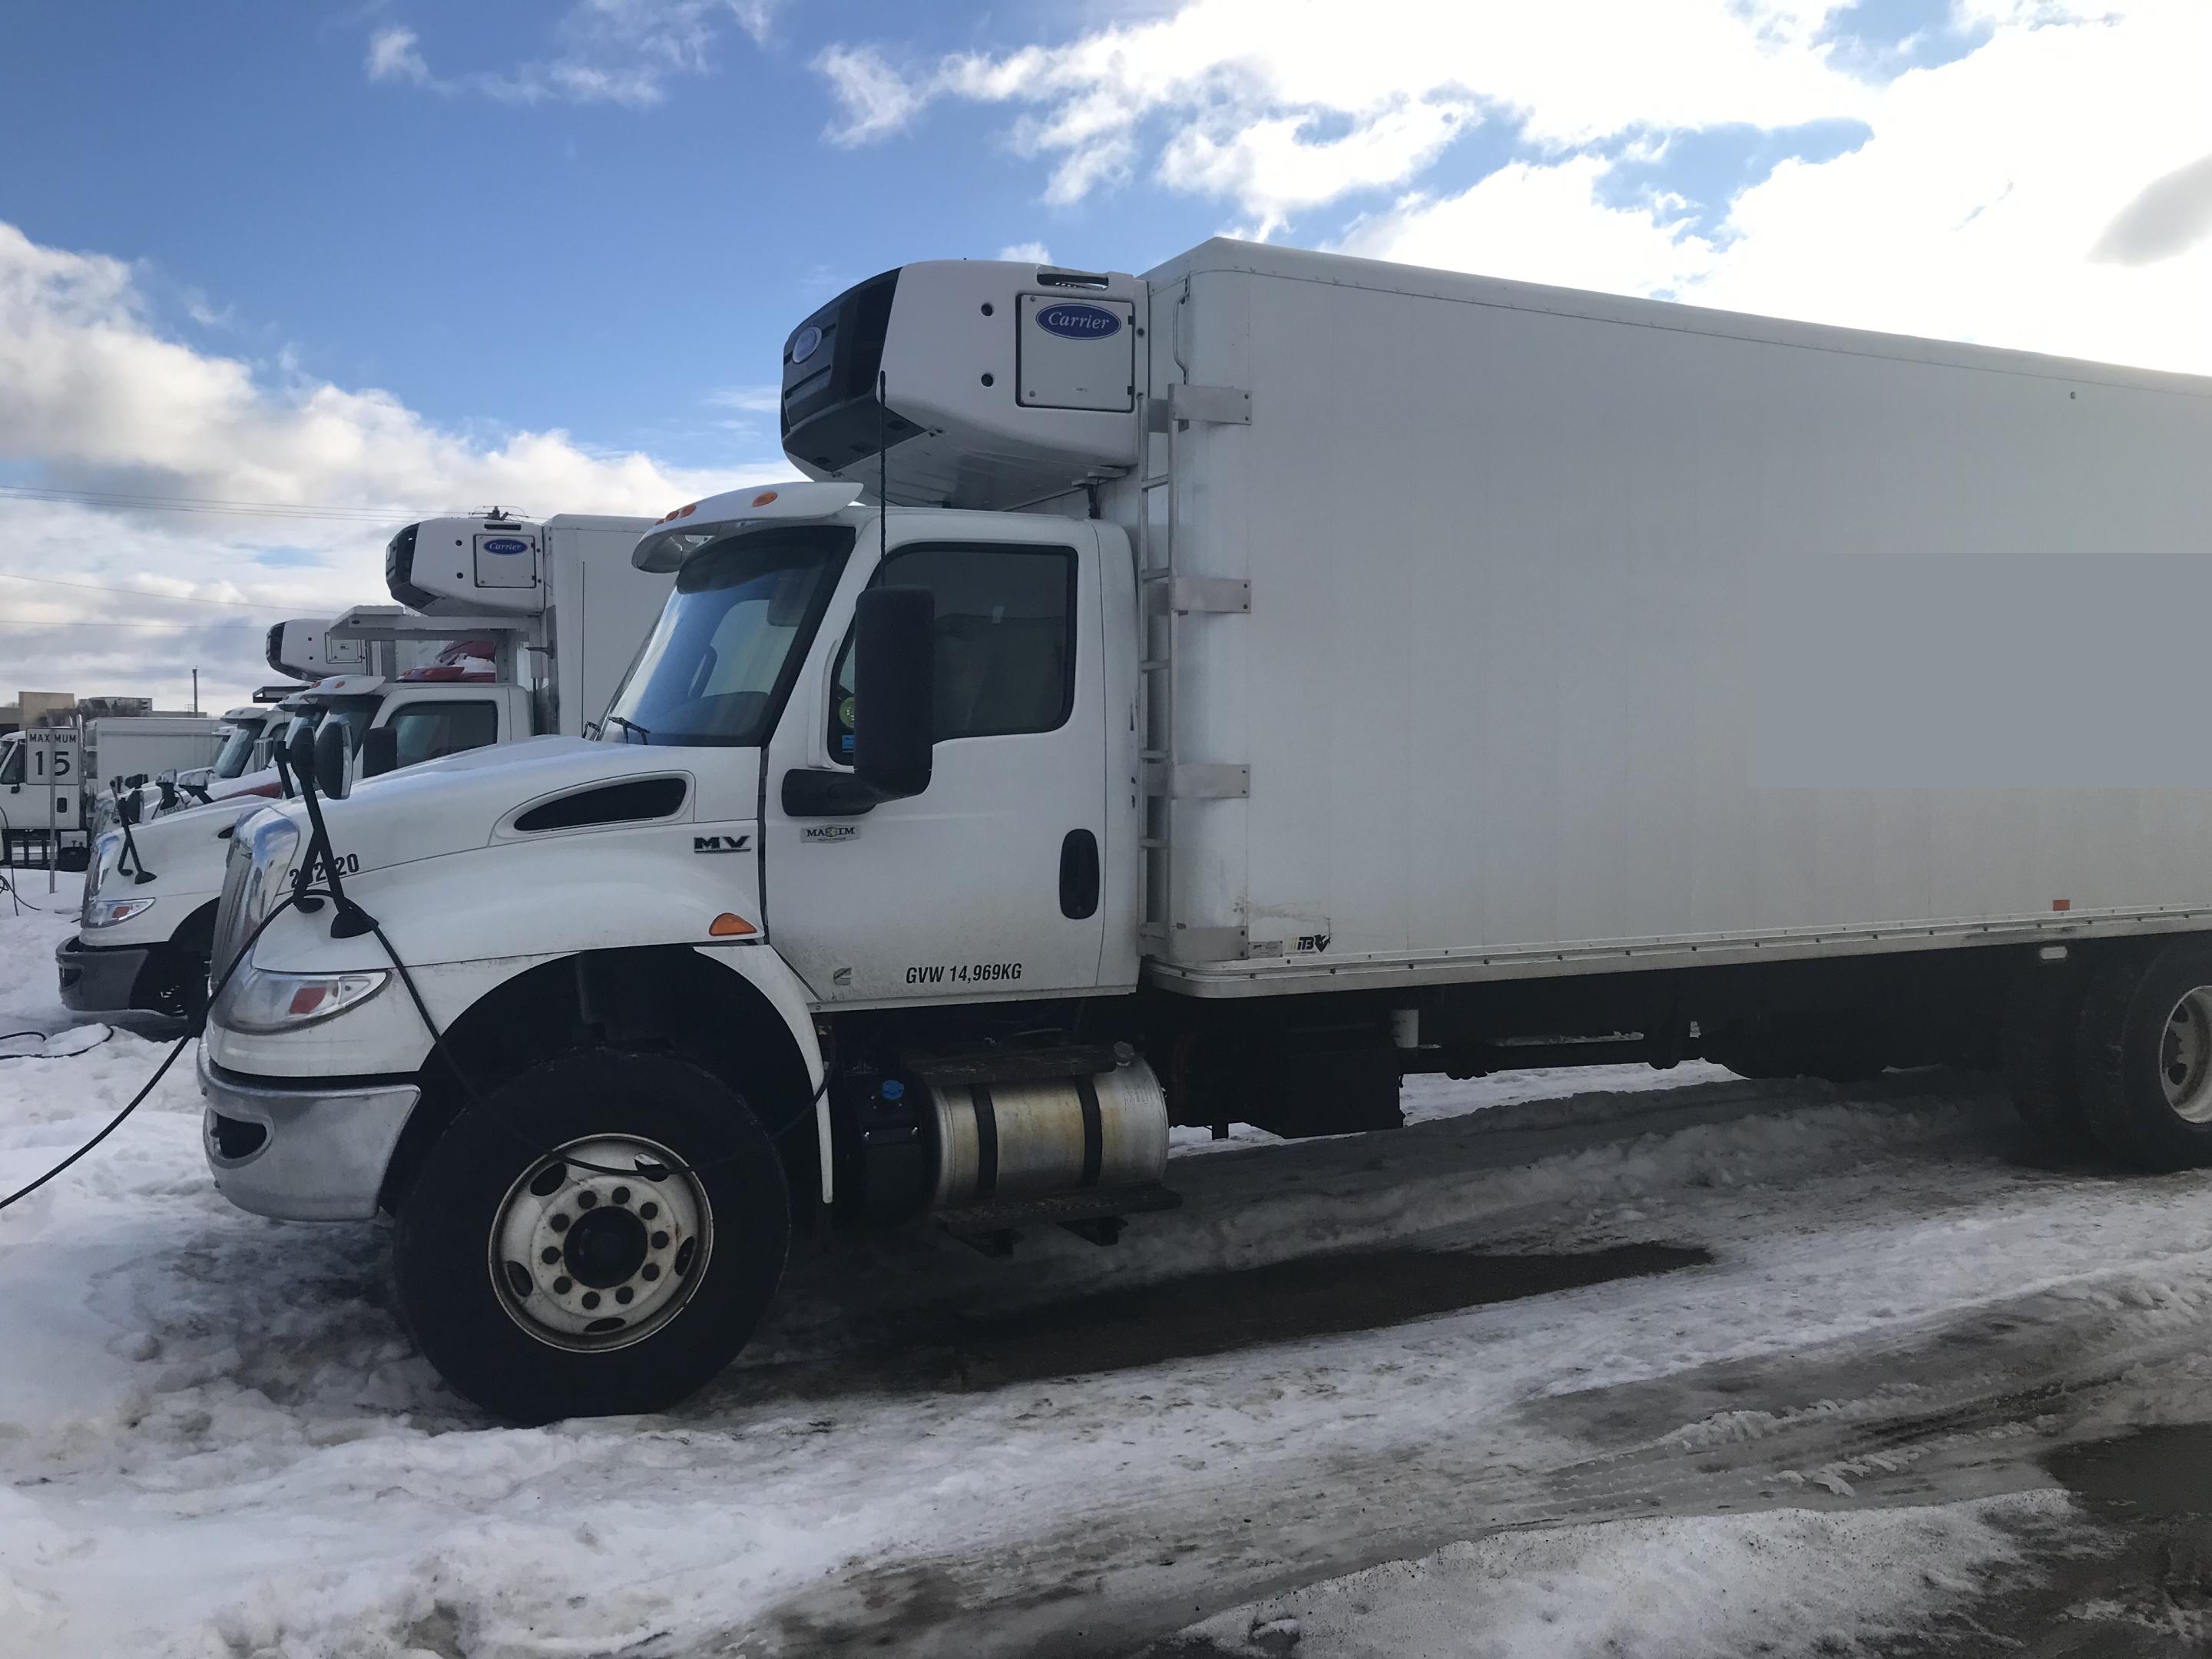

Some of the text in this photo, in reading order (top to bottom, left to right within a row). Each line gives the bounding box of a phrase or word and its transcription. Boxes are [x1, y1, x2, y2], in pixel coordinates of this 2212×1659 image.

[1048, 312, 1110, 329] Carrier
[488, 542, 521, 551] Carrier
[29, 733, 77, 743] MAXMUM
[35, 750, 70, 777] 15
[694, 836, 750, 849] MV
[906, 962, 1022, 984] GVW 14,969KG
